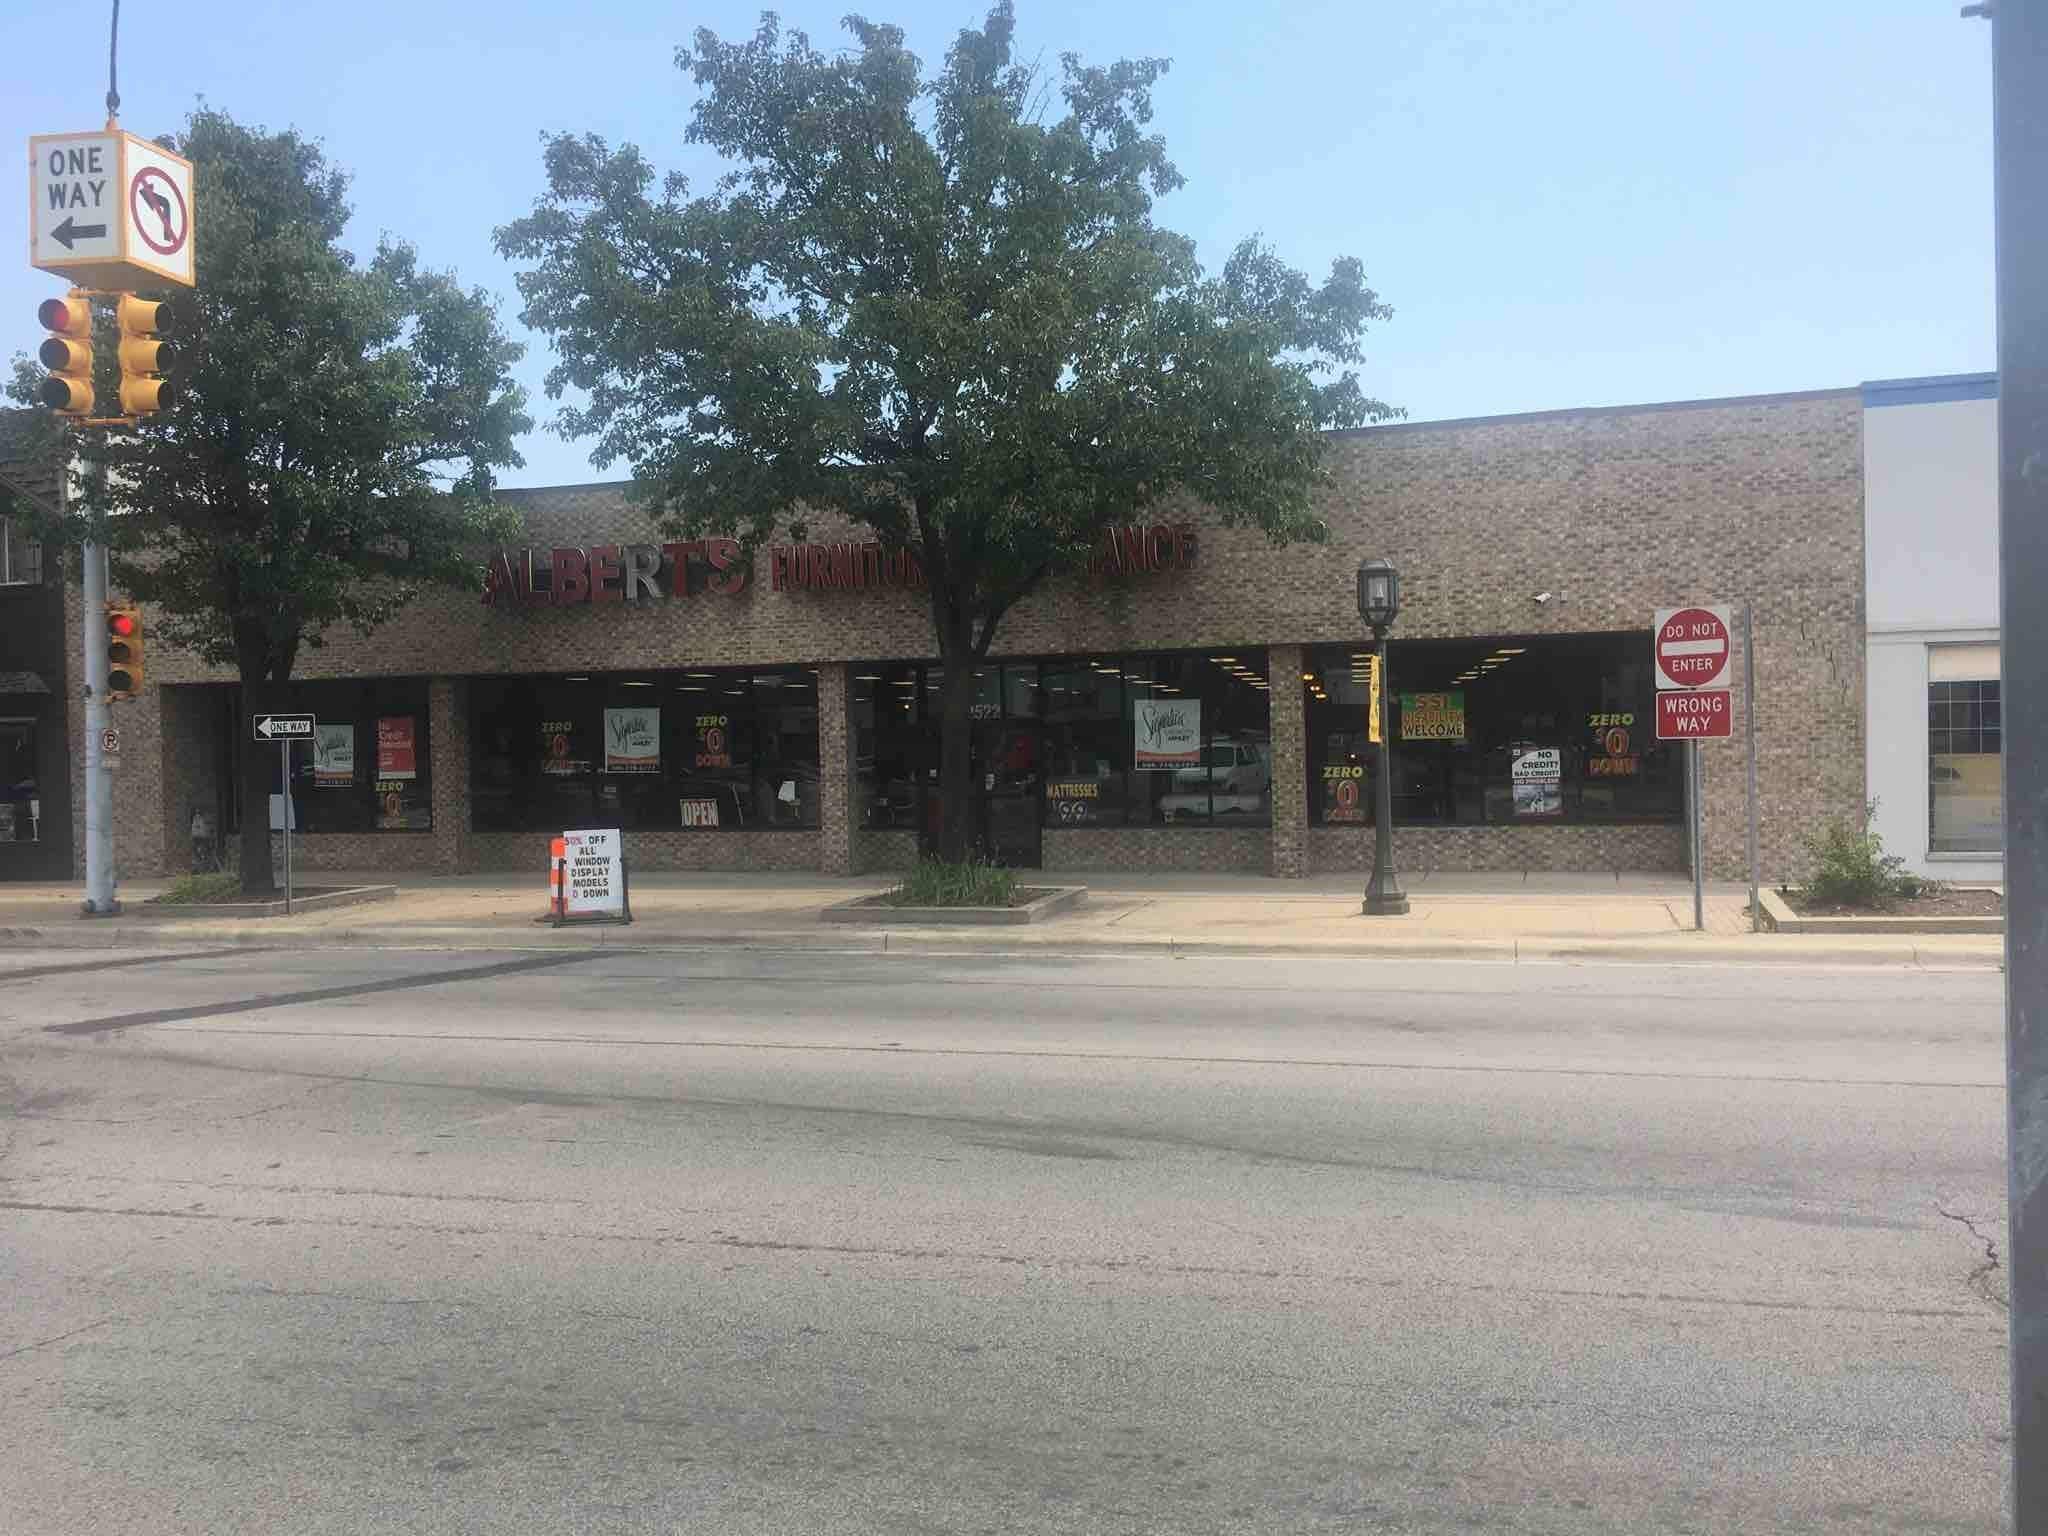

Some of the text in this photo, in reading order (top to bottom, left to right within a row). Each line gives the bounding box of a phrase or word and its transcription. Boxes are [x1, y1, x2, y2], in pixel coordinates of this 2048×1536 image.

[49, 147, 103, 176] ONE
[48, 180, 106, 210] WAY
[1666, 623, 1717, 638] DO NOT
[1672, 658, 1713, 672] ENTER
[1665, 697, 1722, 713] WRONG
[696, 716, 728, 727] ZERO
[1590, 713, 1634, 726] ZERO
[1676, 717, 1711, 731] WAY
[271, 721, 309, 732] ONE WAY
[1403, 724, 1463, 736] WELCOME
[1537, 751, 1553, 759] NO
[1323, 766, 1363, 778] ZERO
[682, 801, 718, 826] OPEN
[589, 836, 607, 844] OFF
[579, 848, 596, 856] ALL
[575, 857, 610, 866] WINDOW
[571, 868, 608, 877] DISPLAY
[573, 878, 609, 888] MODELS
[583, 889, 609, 898] DOWN
